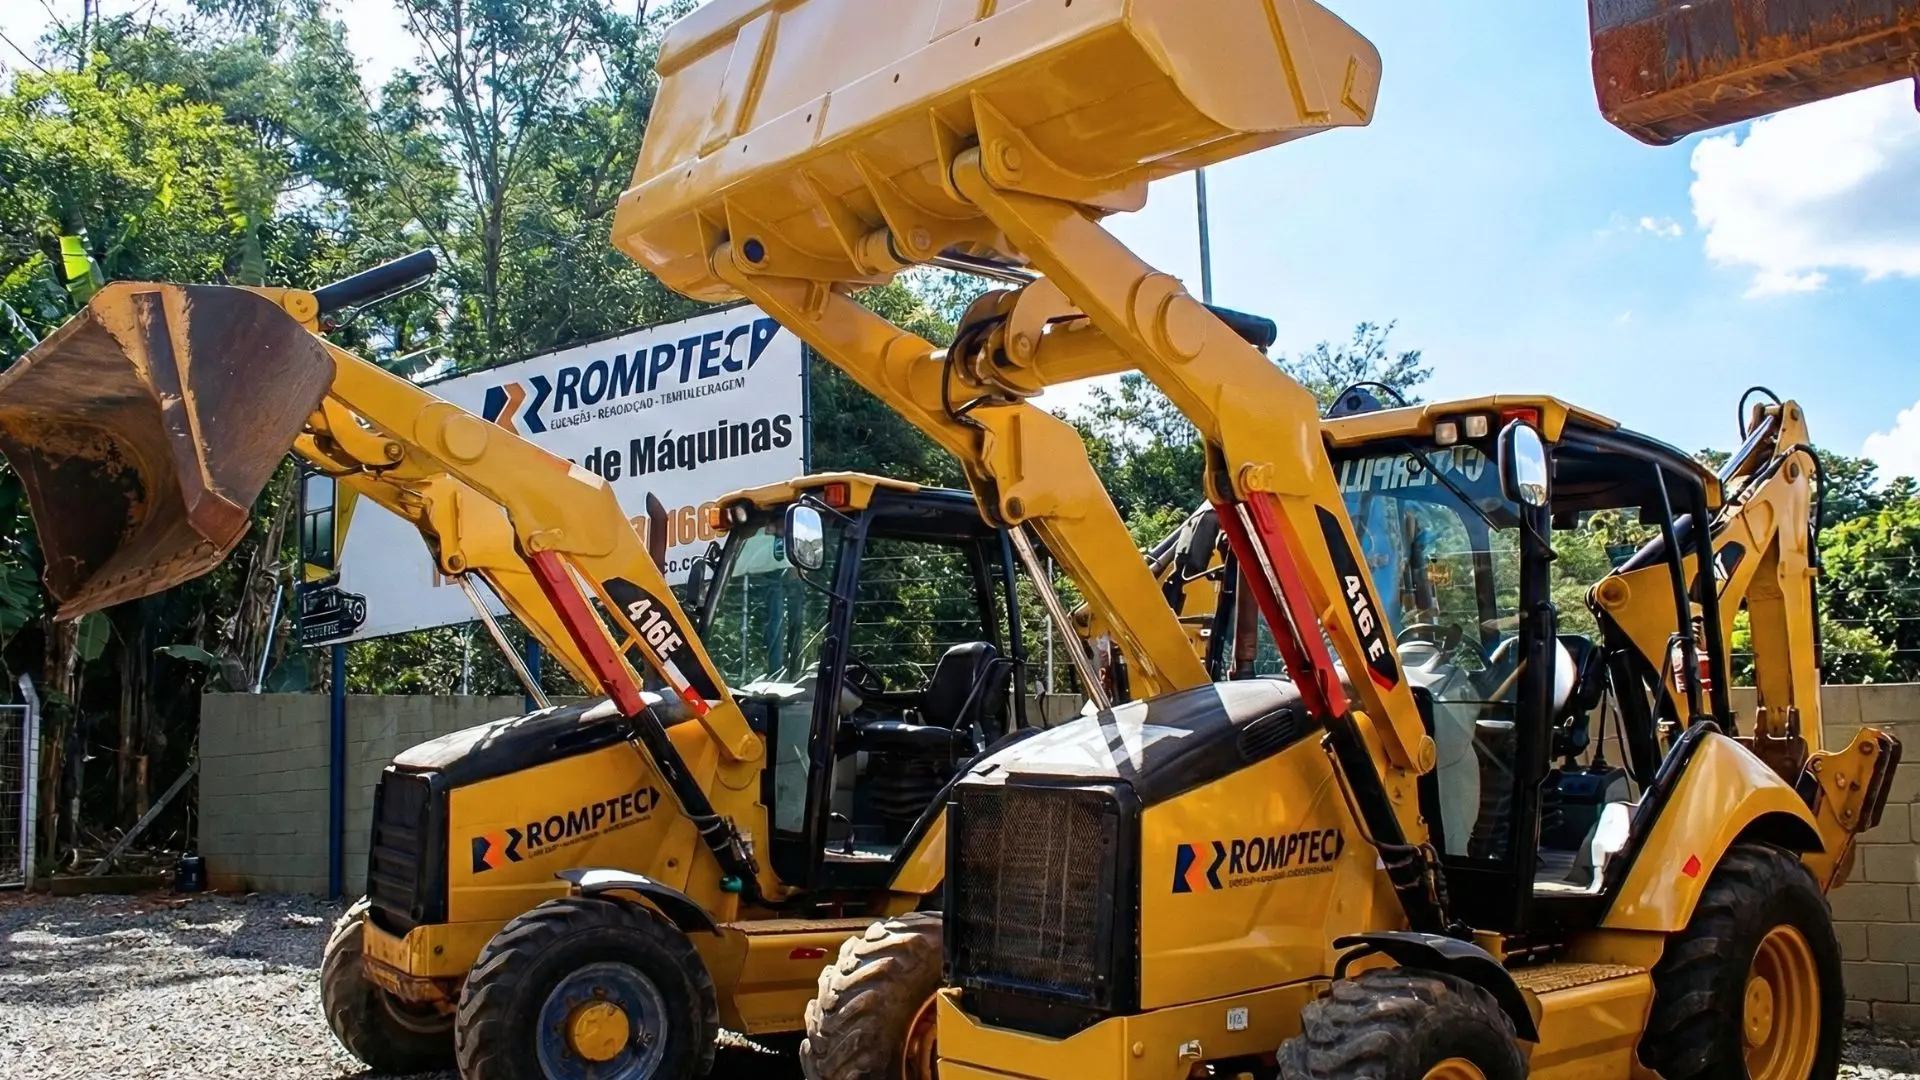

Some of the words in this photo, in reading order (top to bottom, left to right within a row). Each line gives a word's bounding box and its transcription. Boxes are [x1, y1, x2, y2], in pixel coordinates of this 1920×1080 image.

[553, 322, 751, 413] ROMPTEC
[585, 446, 622, 482] de
[630, 413, 793, 477] Máquinas
[627, 598, 683, 660] 416E
[526, 787, 650, 849] ROMPTEC
[1229, 828, 1335, 875] ROMPTEC
